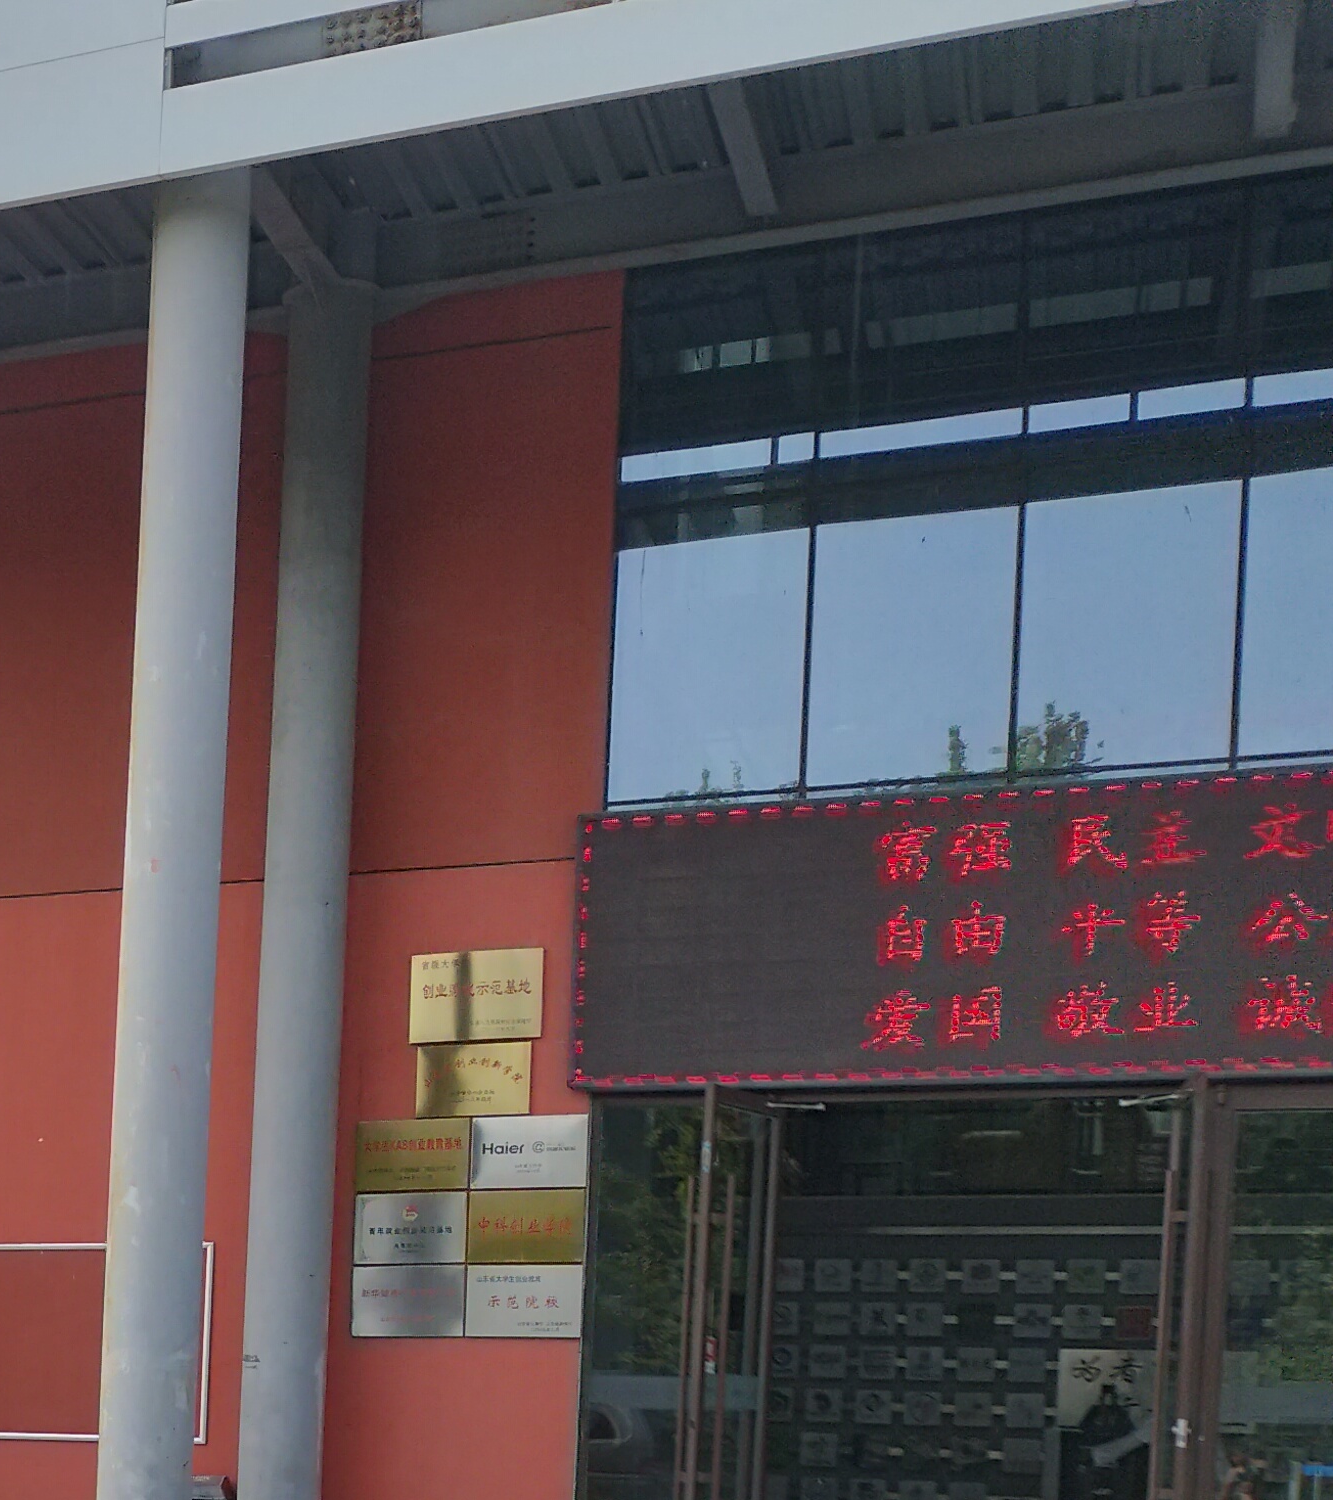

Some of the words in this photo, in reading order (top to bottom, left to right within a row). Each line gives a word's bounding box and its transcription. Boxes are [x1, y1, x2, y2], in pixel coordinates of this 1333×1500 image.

[1242, 803, 1333, 860] 文
[882, 901, 1008, 962] 自由
[1061, 890, 1202, 956] 平等
[861, 986, 1004, 1049] 爱国
[1056, 981, 1200, 1037] 敬业
[482, 1141, 525, 1155] Haier
